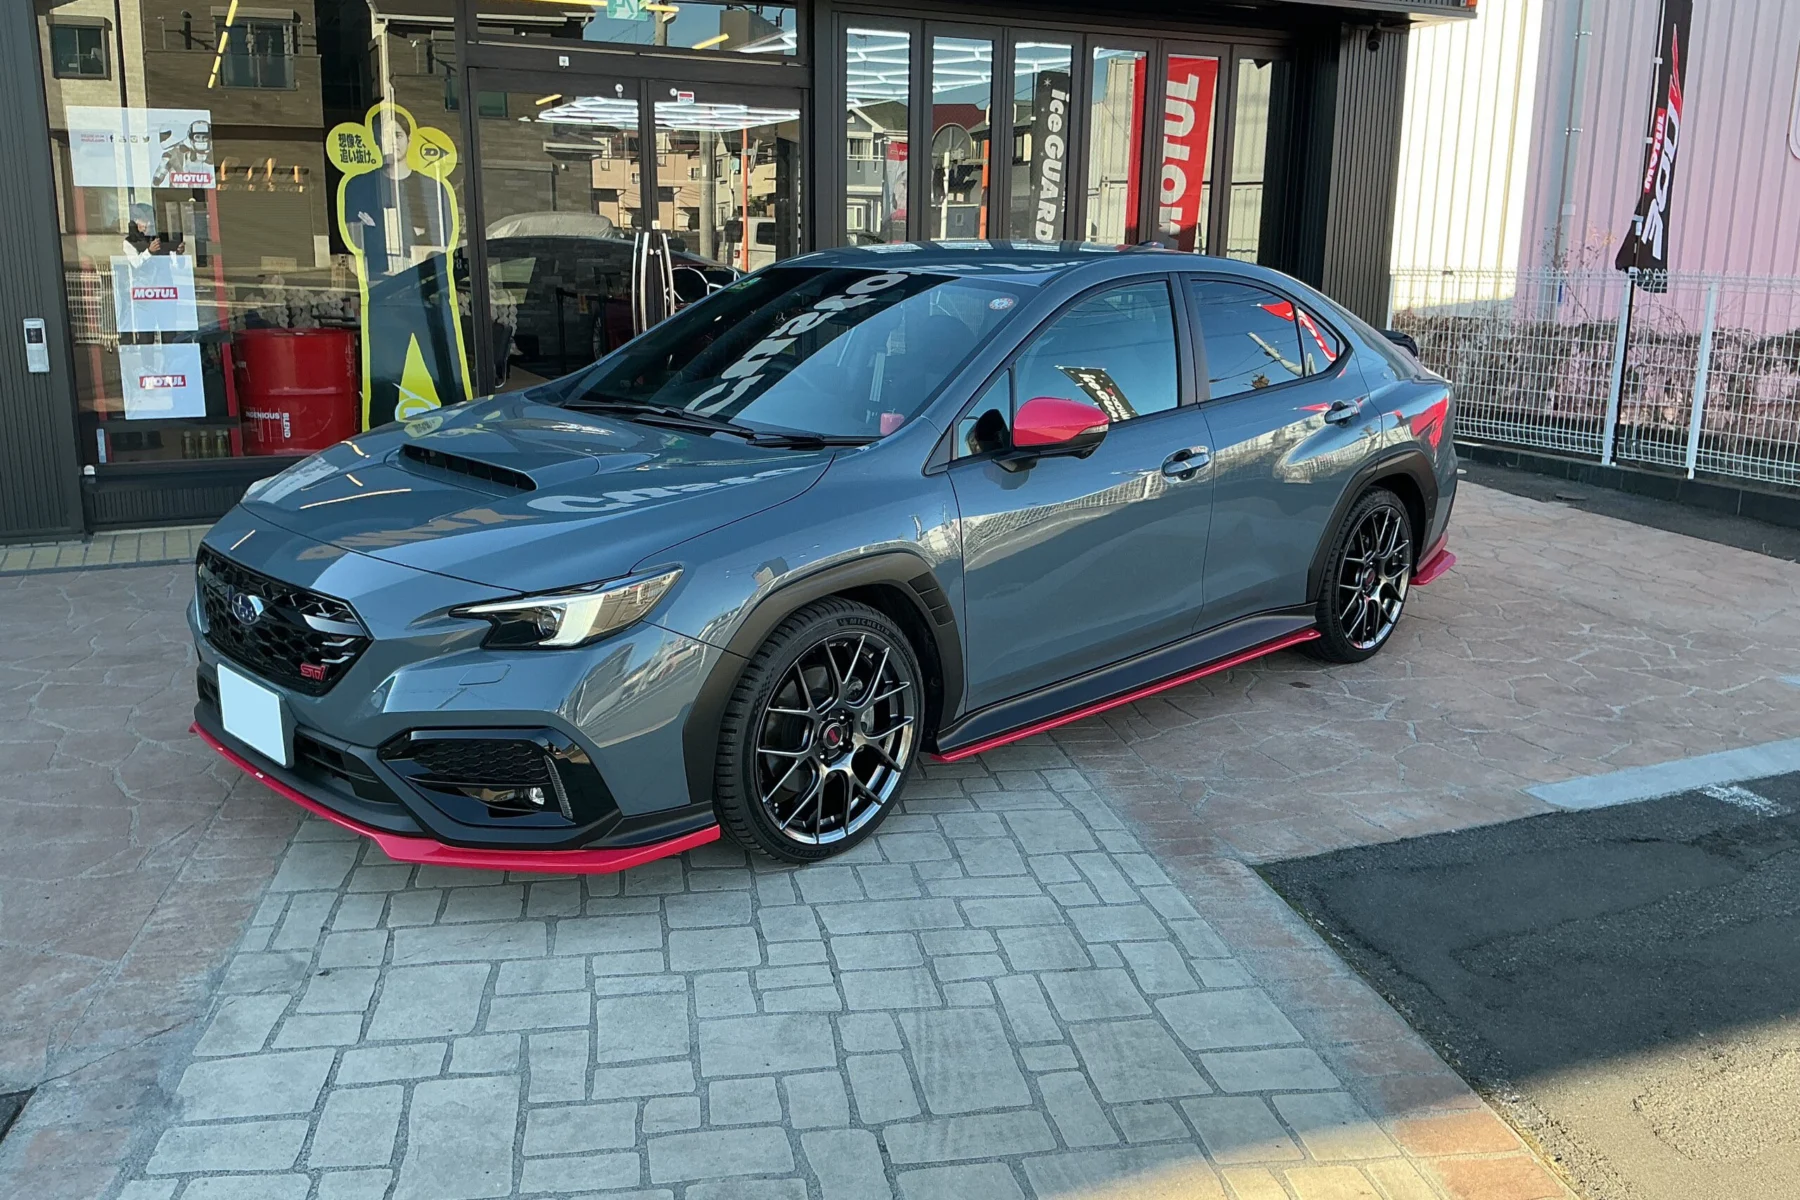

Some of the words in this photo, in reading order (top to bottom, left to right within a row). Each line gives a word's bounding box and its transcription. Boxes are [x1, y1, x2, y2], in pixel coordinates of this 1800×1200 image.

[1644, 113, 1665, 190] MOTUL
[173, 174, 209, 183] MOTUL
[133, 288, 177, 299] MOTUL
[141, 376, 184, 387] MOTUL
[245, 411, 280, 420] NGENIOUS
[849, 618, 890, 635] MICHELIN
